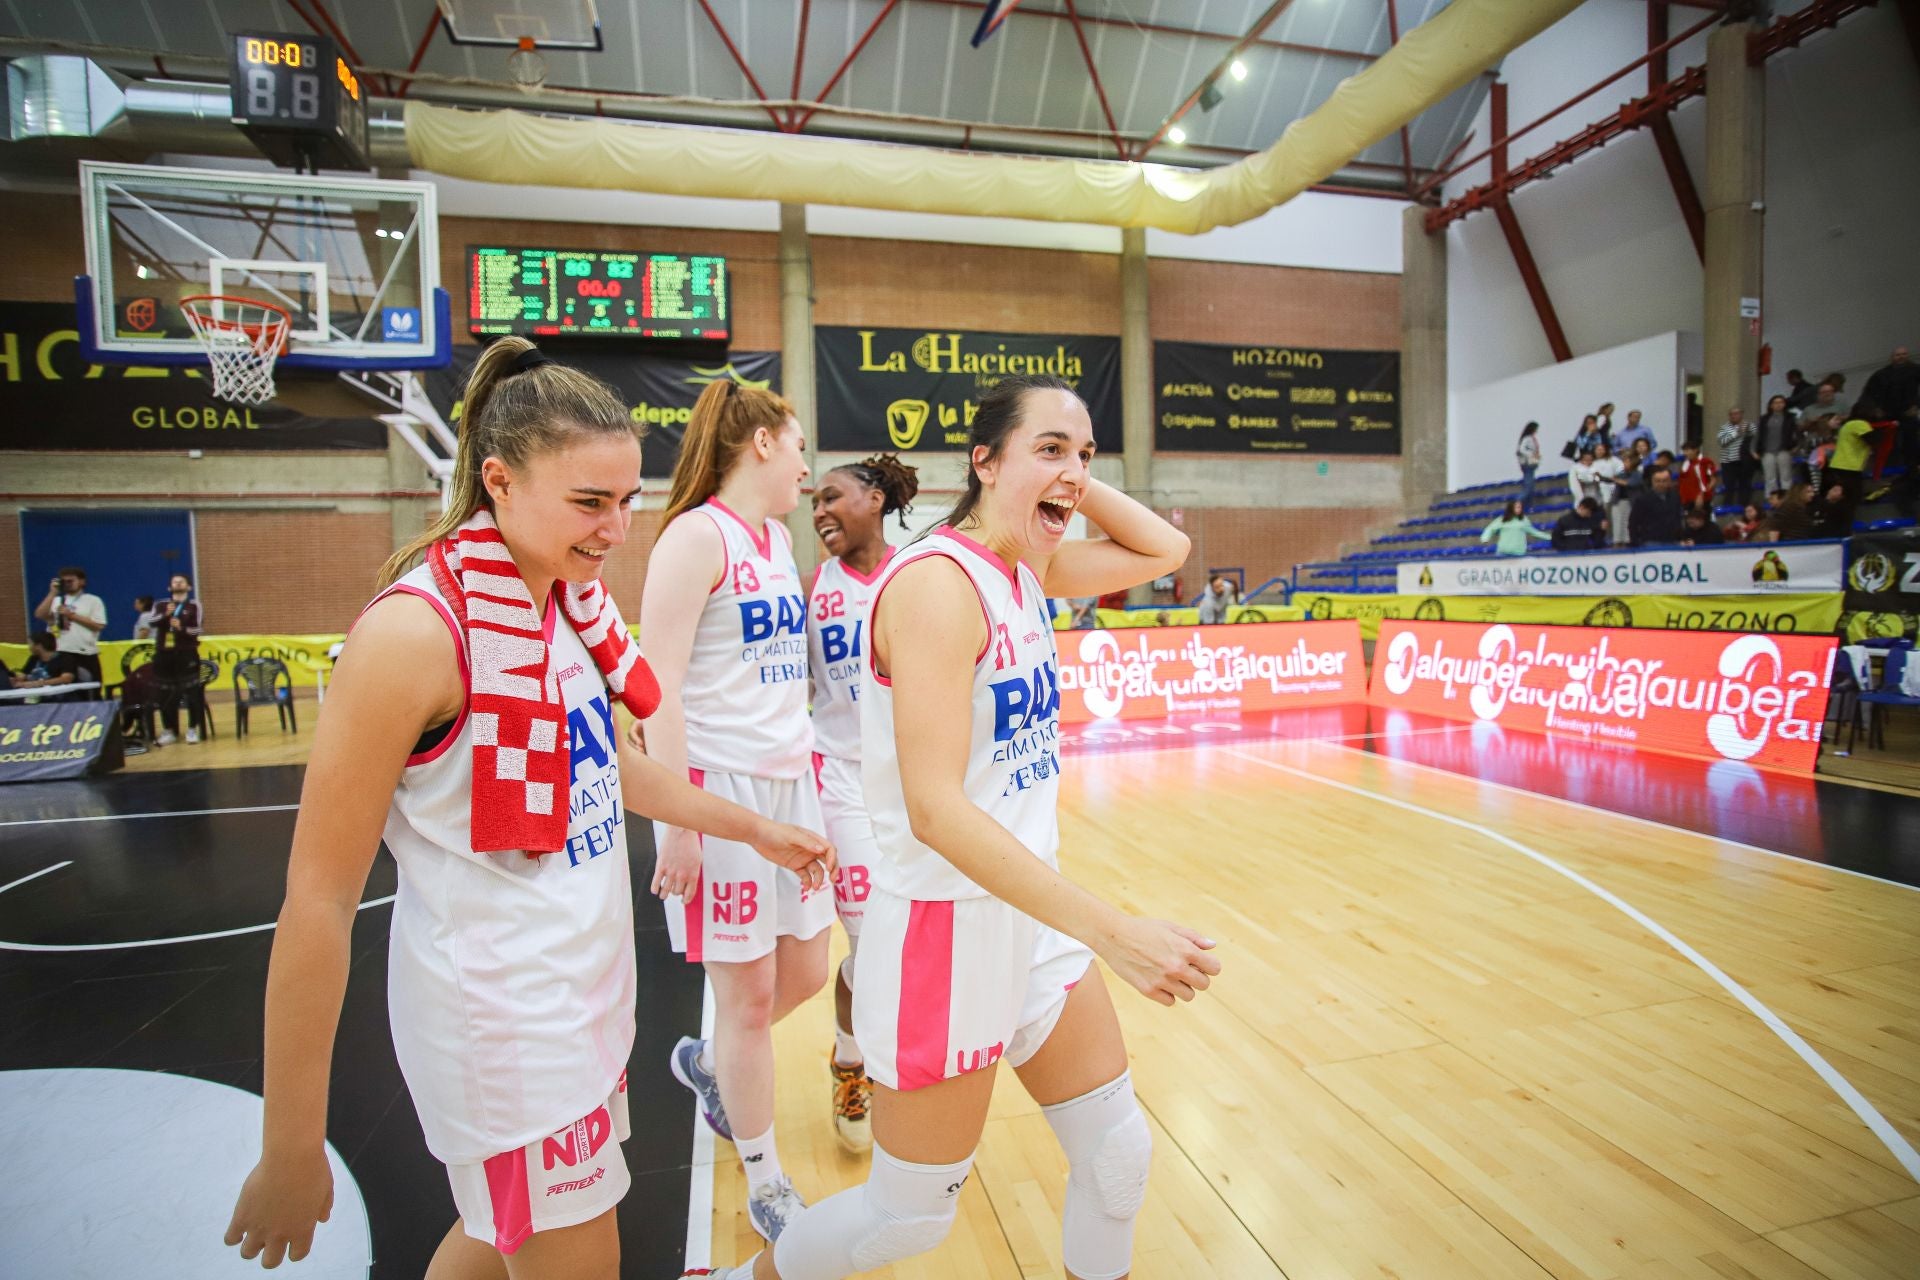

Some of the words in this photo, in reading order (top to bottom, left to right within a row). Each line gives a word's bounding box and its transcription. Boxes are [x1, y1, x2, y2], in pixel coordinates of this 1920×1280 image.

[858, 331, 907, 372] La
[925, 333, 1083, 377] Hacienda
[1233, 350, 1323, 369] HOZONO
[132, 407, 260, 430] GLOBAL
[732, 560, 761, 596] 13
[1457, 568, 1513, 586] GRADA
[1518, 566, 1607, 584] HOZONO
[1614, 563, 1709, 584] GLOBAL
[815, 590, 845, 622] 32
[1666, 611, 1797, 632] HOZONO
[1232, 638, 1347, 695] alquiber
[31, 723, 63, 747] te
[69, 715, 103, 744] lía
